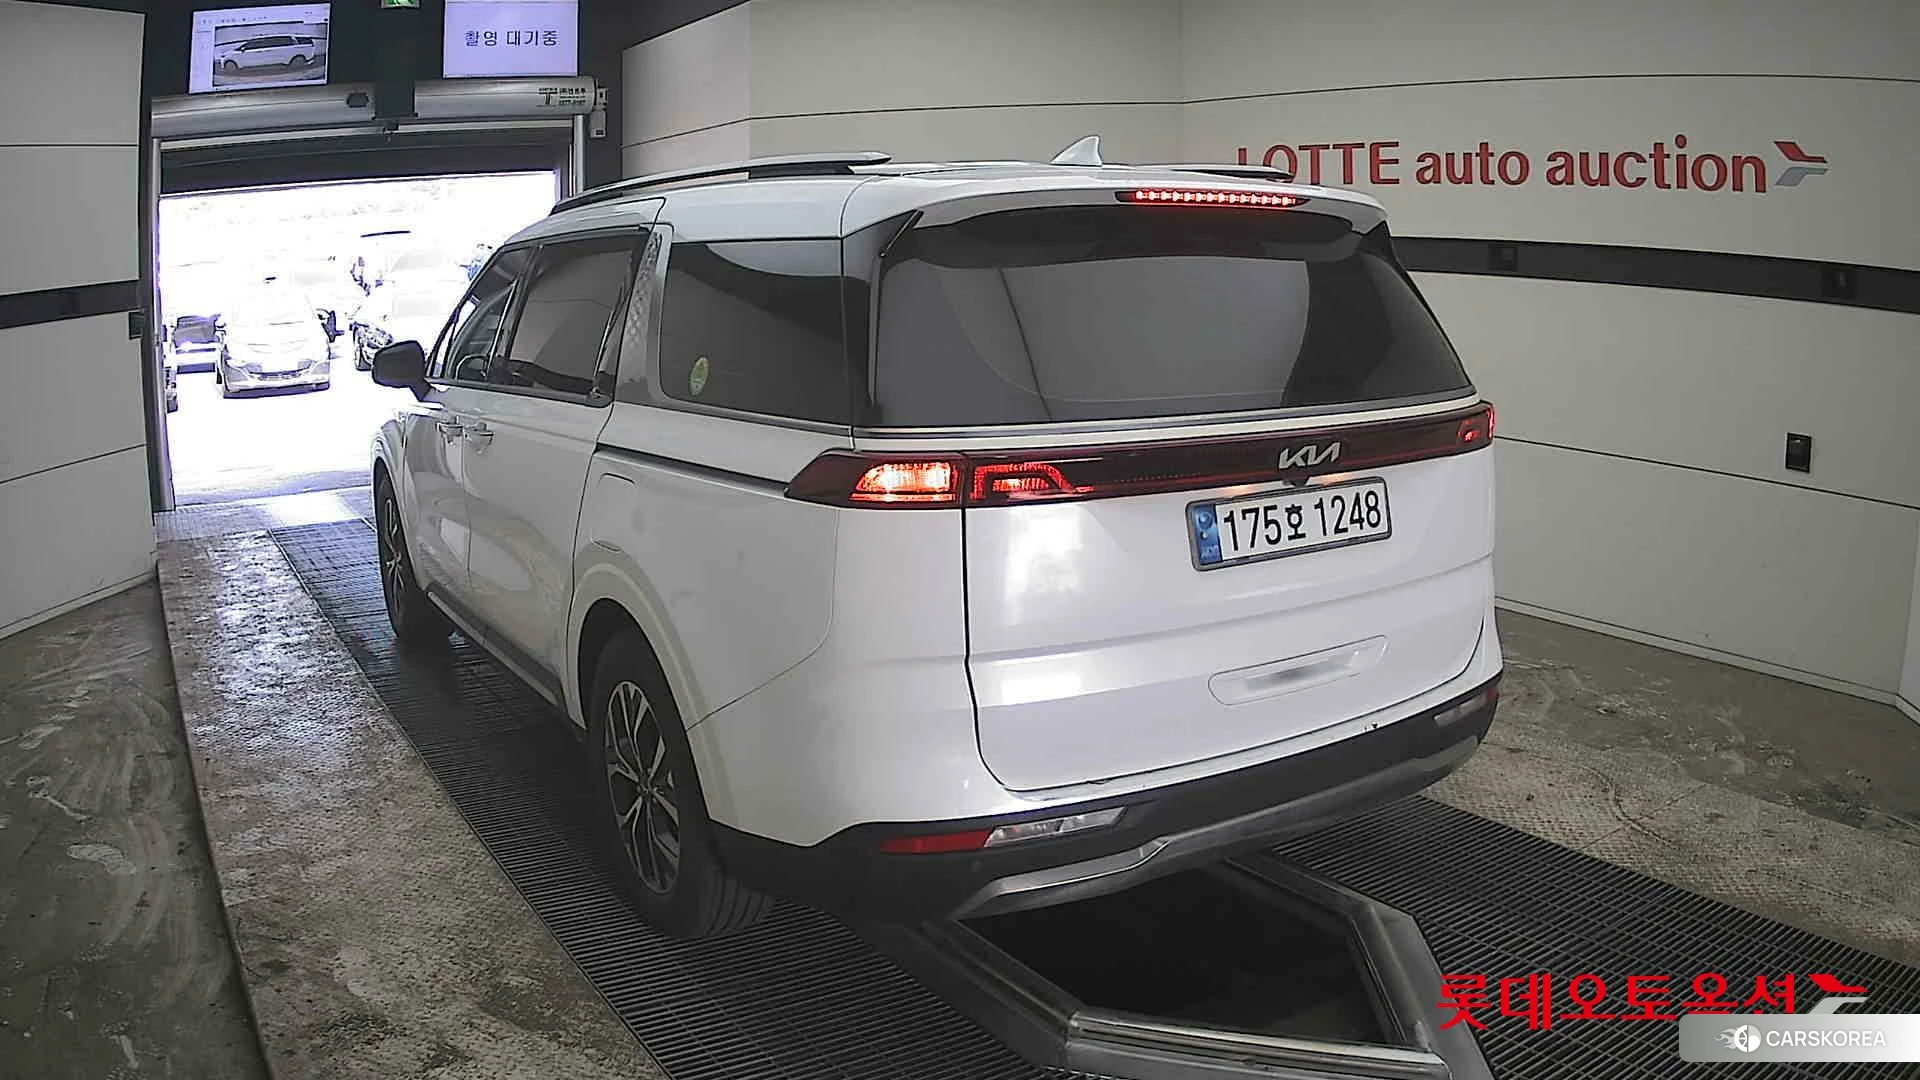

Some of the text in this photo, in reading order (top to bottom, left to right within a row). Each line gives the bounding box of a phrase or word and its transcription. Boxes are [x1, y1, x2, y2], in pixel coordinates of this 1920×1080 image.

[465, 30, 557, 47] 촬영 대기중
[1415, 143, 1530, 186] auto
[1545, 134, 1766, 193] auction
[1223, 490, 1382, 551] 175호 1248
